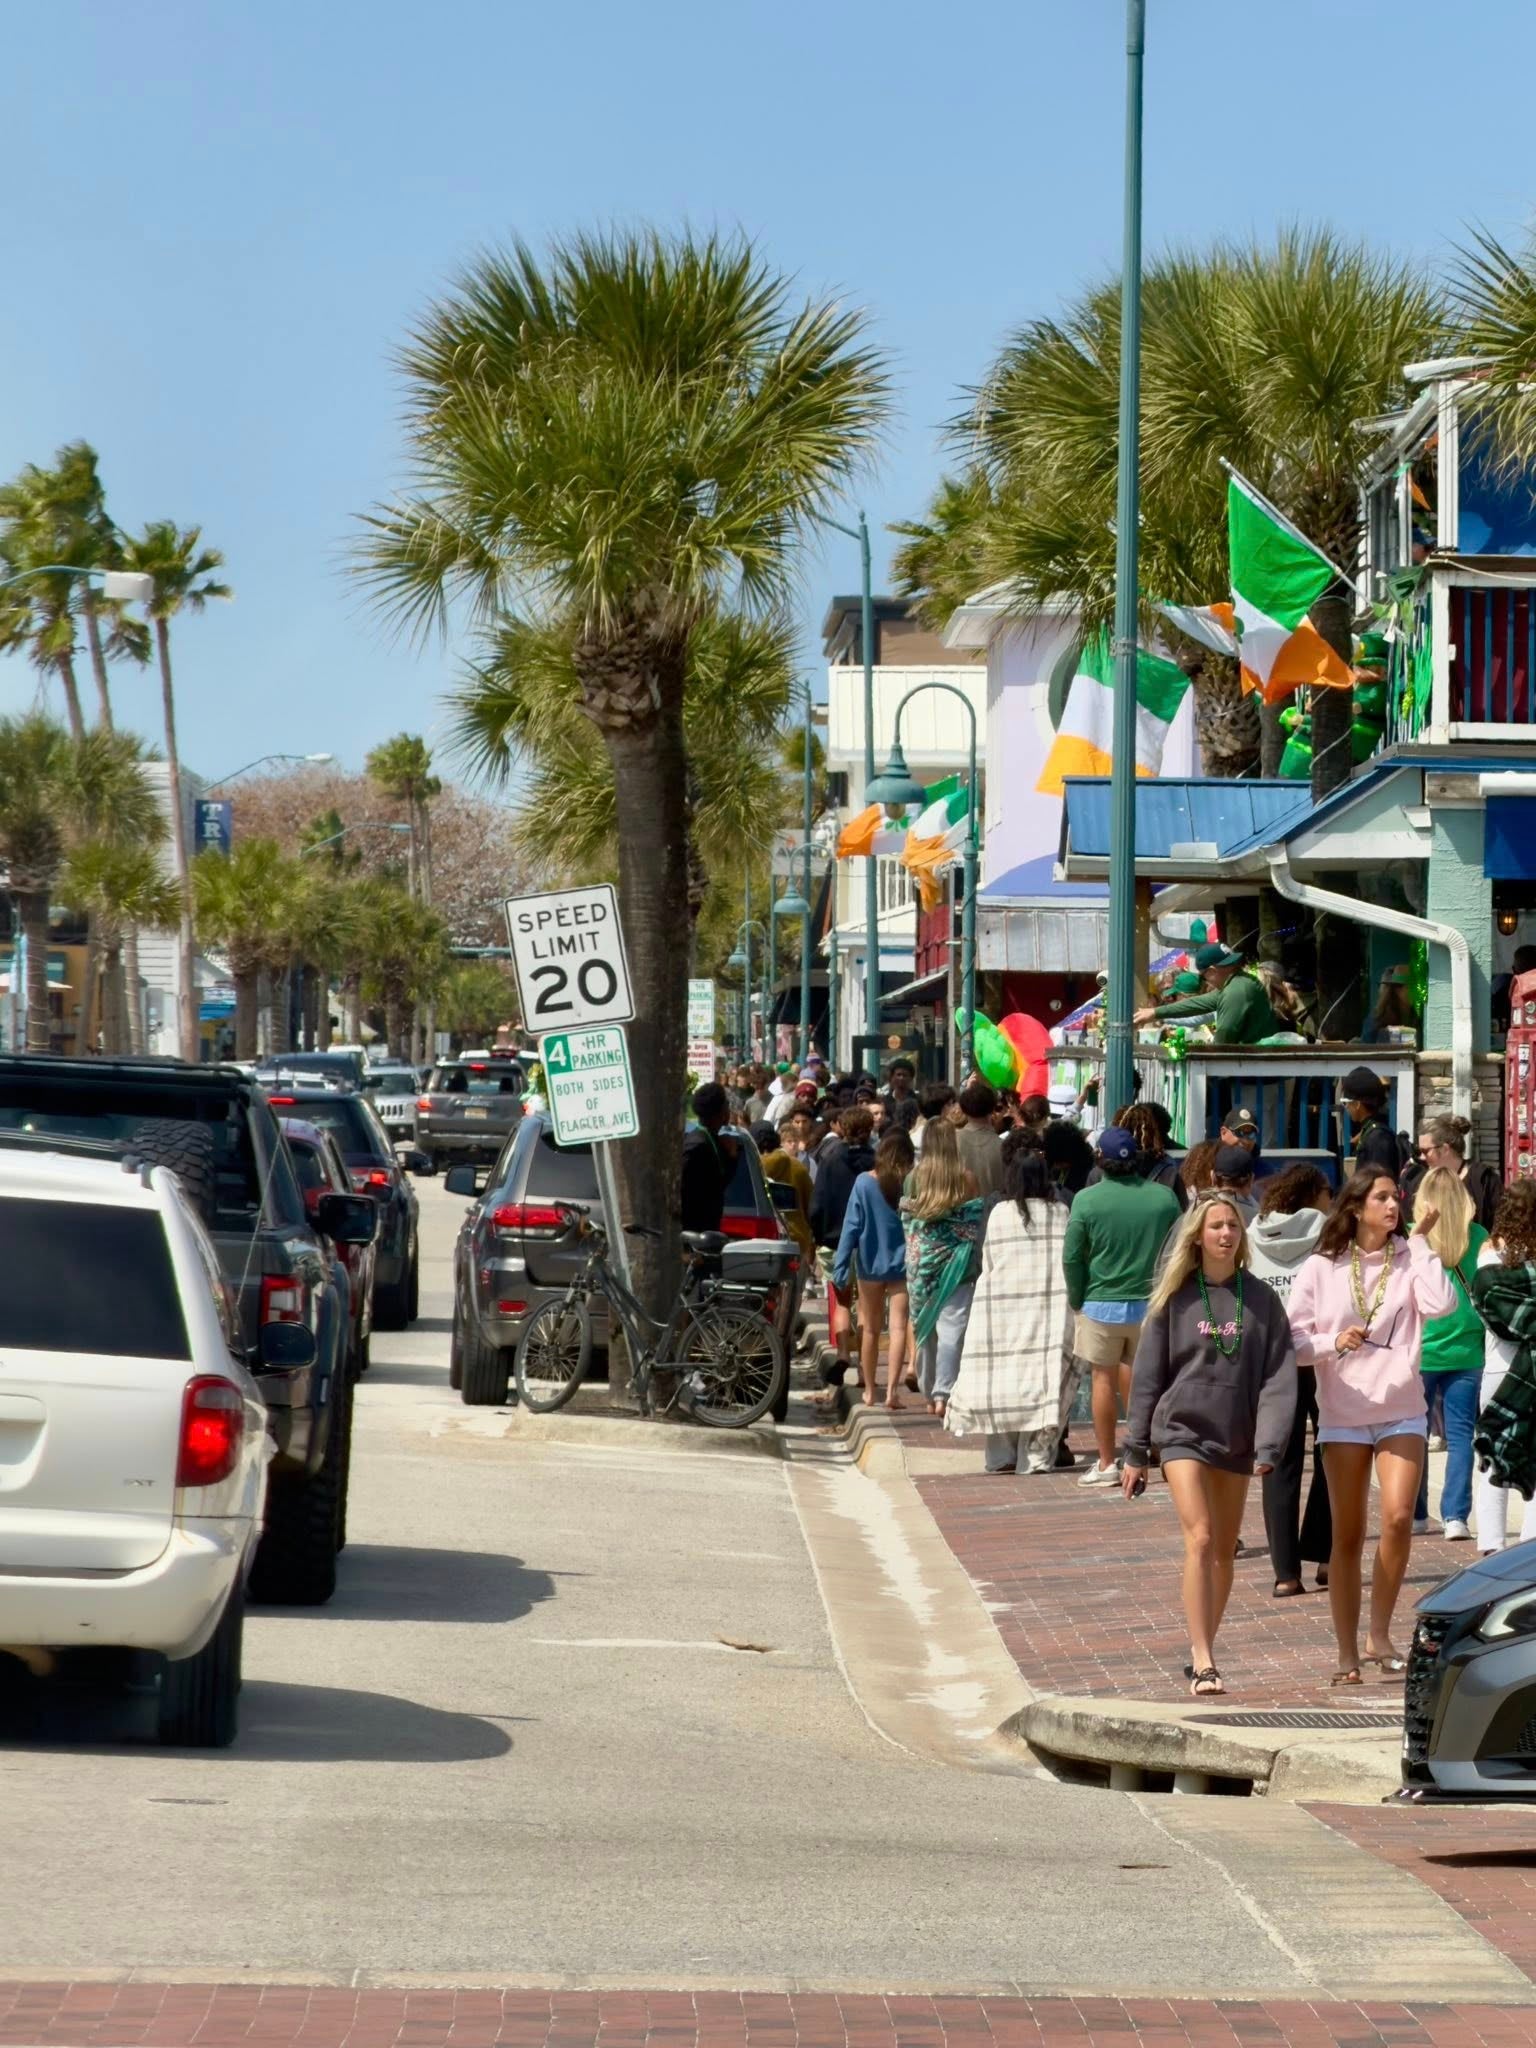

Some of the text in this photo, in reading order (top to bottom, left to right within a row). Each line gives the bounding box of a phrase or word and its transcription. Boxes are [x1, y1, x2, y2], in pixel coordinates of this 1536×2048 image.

[518, 903, 607, 933] SPEED
[531, 931, 600, 959] LIMIT
[529, 958, 618, 1014] 20
[548, 1040, 567, 1067] 4
[572, 1049, 622, 1068] PARKING
[556, 1076, 624, 1096] BOTH SIDES
[586, 1097, 599, 1110] OF
[560, 1112, 631, 1133] FLAGLER AVE
